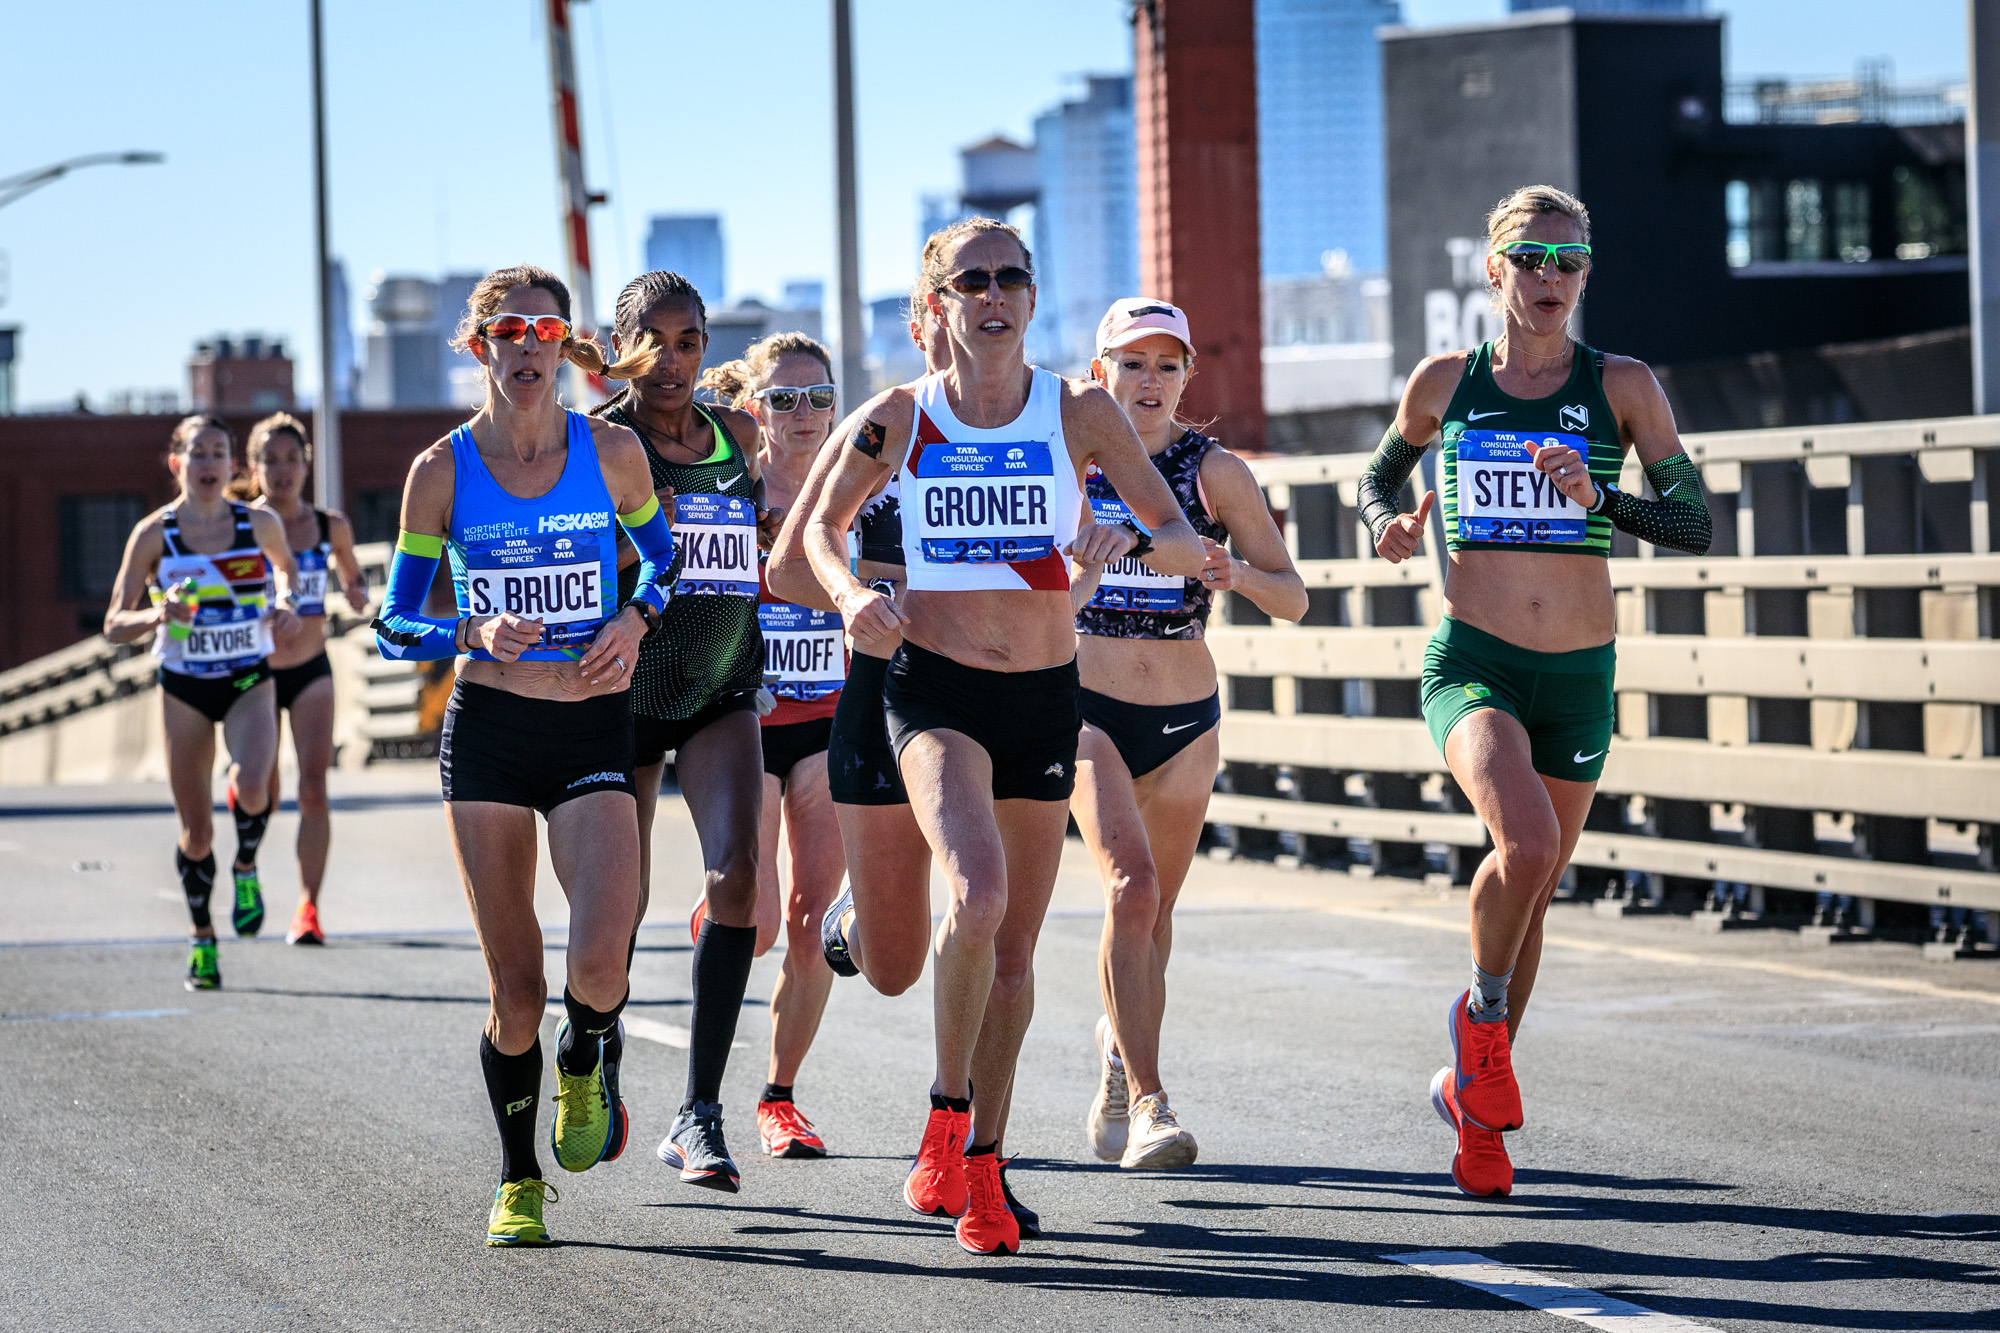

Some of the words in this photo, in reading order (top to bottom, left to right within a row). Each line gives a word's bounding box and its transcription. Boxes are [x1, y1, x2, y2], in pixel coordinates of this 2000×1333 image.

[1423, 289, 1498, 356] BO
[1481, 442, 1526, 450] CONSULTANC
[1489, 449, 1521, 457] SERVICES
[941, 455, 994, 463] CONSULTANCY
[1004, 461, 1027, 469] TATA
[692, 496, 710, 504] TATA
[680, 504, 720, 512] CONSULTANCY
[925, 485, 1047, 527] GRONER
[1101, 503, 1121, 511] TATA
[591, 511, 609, 520] ONE
[687, 511, 714, 520] SERVICES
[727, 511, 744, 519] TATA
[1092, 510, 1134, 519] ONSULTANCY
[538, 513, 593, 533] HOKA
[592, 519, 610, 529] ONE
[463, 521, 515, 535] NORTHERN
[1490, 520, 1550, 540] 2018
[463, 532, 501, 542] ARIZONA
[504, 527, 530, 538] ELITE
[505, 539, 528, 547] TATA
[491, 546, 543, 557] CONSULTANCY
[553, 551, 576, 559] TATA
[954, 540, 1018, 561] 2018
[501, 555, 534, 564] SERVICES
[472, 577, 499, 615] S.
[504, 570, 598, 614] BRUCE
[1093, 588, 1149, 609] 2018
[765, 638, 835, 673] IMOFF
